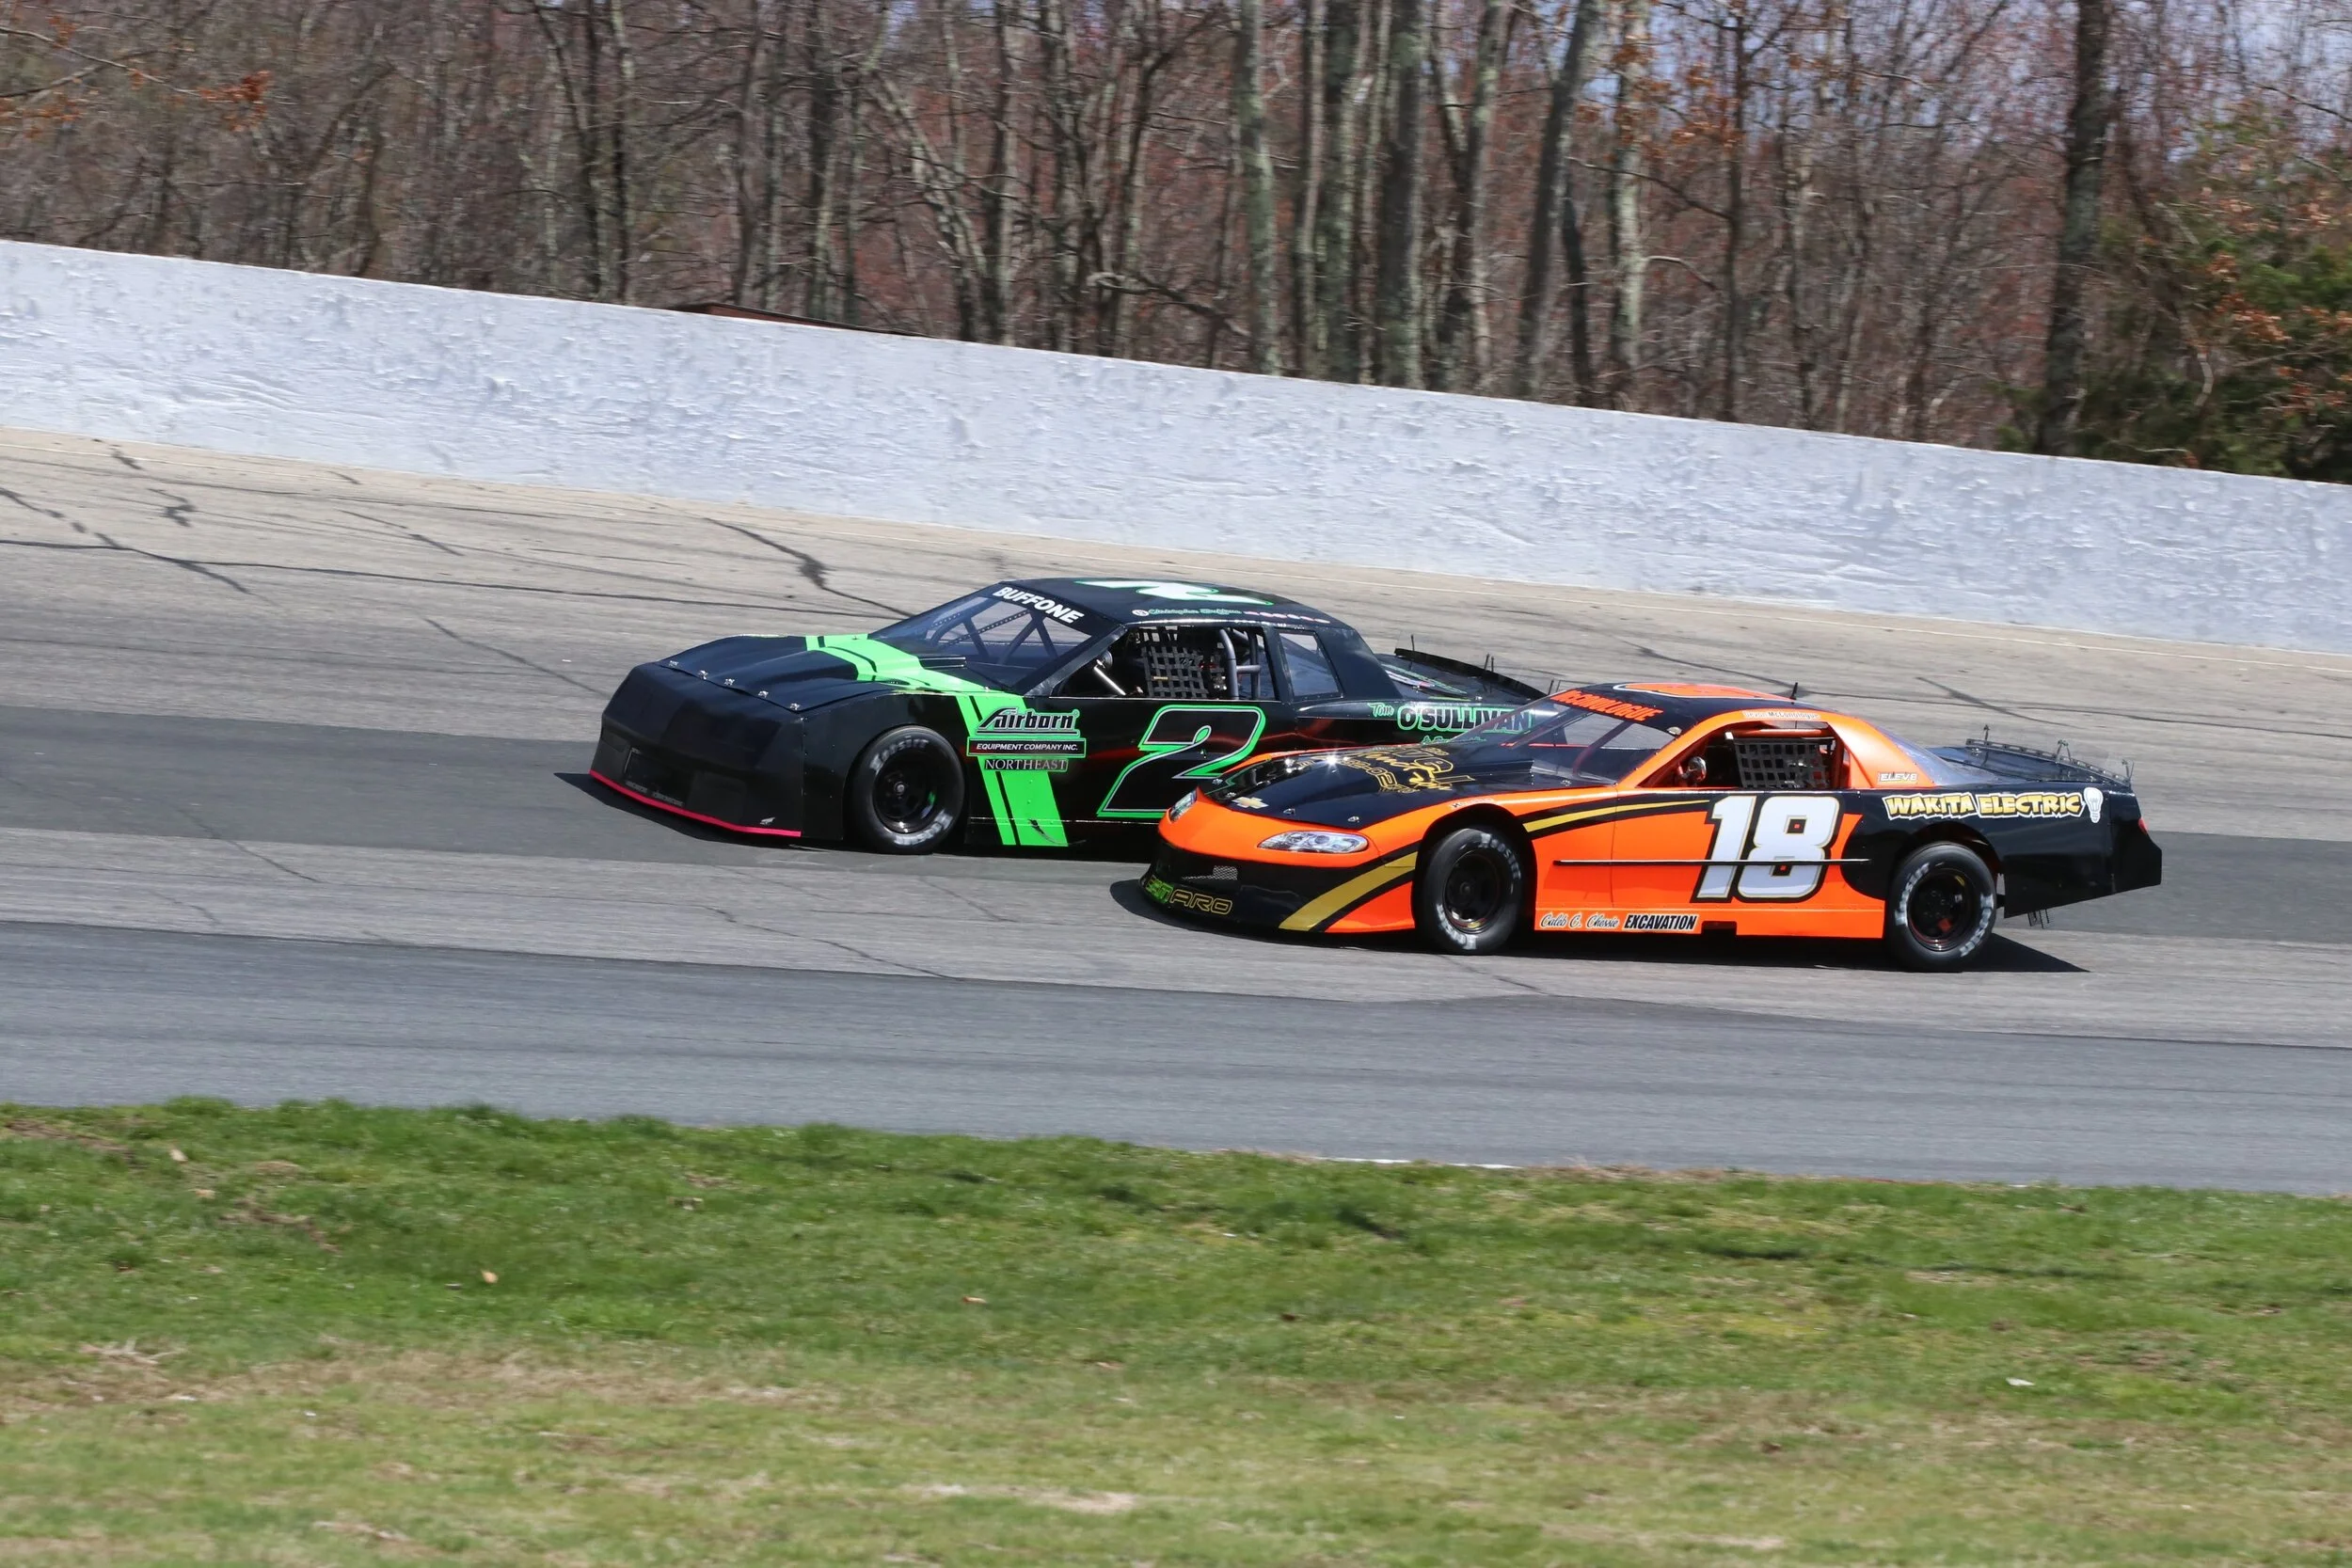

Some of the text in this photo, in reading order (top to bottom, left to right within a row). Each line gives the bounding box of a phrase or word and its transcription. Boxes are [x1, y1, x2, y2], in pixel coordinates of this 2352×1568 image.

[993, 586, 1085, 624] BUFFONE
[978, 707, 1076, 730] Airborn
[1397, 704, 1536, 734] O'SULLIVAN
[985, 759, 1067, 770] NORTHEAST
[1097, 705, 1266, 818] 2
[1884, 793, 2083, 817] WAKITA ELECTRIC
[1694, 795, 1841, 899] 18
[1540, 913, 1567, 927] Caleb
[1569, 913, 1581, 928] C.
[1624, 913, 1697, 930] EXCAVATION
